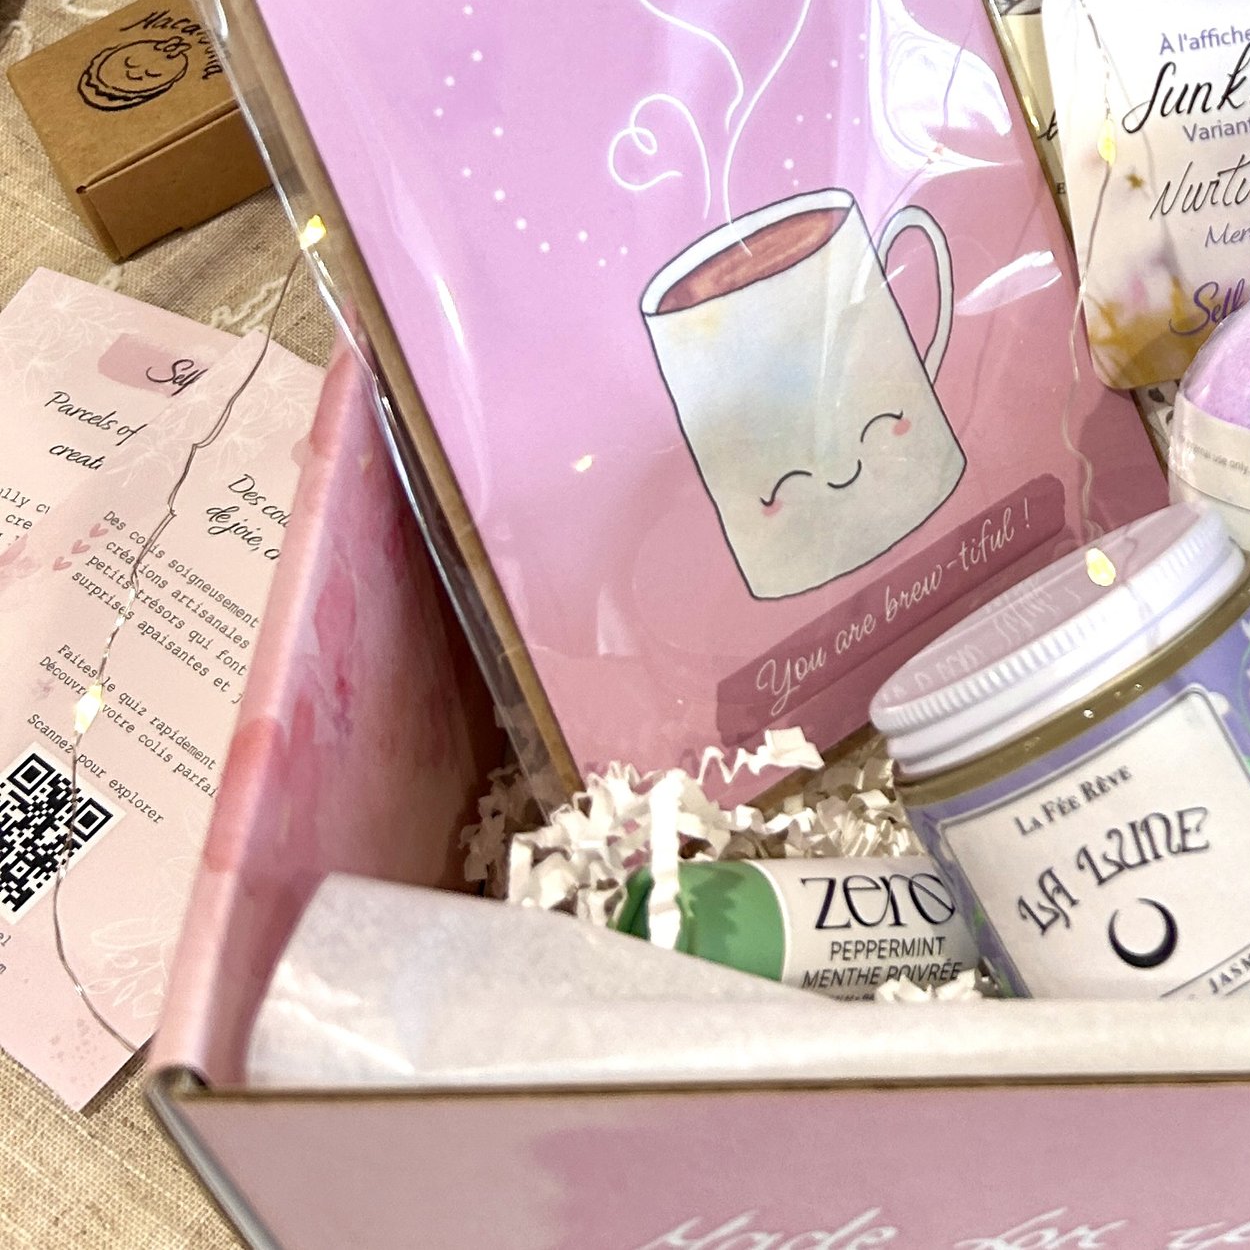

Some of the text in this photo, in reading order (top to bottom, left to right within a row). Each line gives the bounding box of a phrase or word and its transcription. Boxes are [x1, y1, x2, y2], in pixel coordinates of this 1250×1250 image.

[1159, 32, 1175, 56] À
[45, 390, 148, 447] Parcels of
[228, 473, 267, 506] Des
[103, 510, 127, 532] Des
[168, 558, 260, 629] soigneusement
[72, 571, 232, 692] surprises apaisantes et
[85, 555, 248, 677] petits trésors qui font
[171, 588, 250, 650] artisanales
[756, 648, 827, 718] You
[835, 614, 877, 655] are
[884, 507, 1015, 626] brew-tiful
[39, 656, 90, 697] Découvr
[101, 703, 136, 734] votre
[138, 732, 174, 763] colis
[57, 644, 217, 771] Faites le quiz rapidement
[27, 713, 165, 825] Scannez pour explorer
[800, 872, 957, 931] zero
[1017, 866, 1080, 936] LA
[802, 958, 963, 990] MENTHE POIVRÉE
[830, 936, 946, 962] PEPPERMINT
